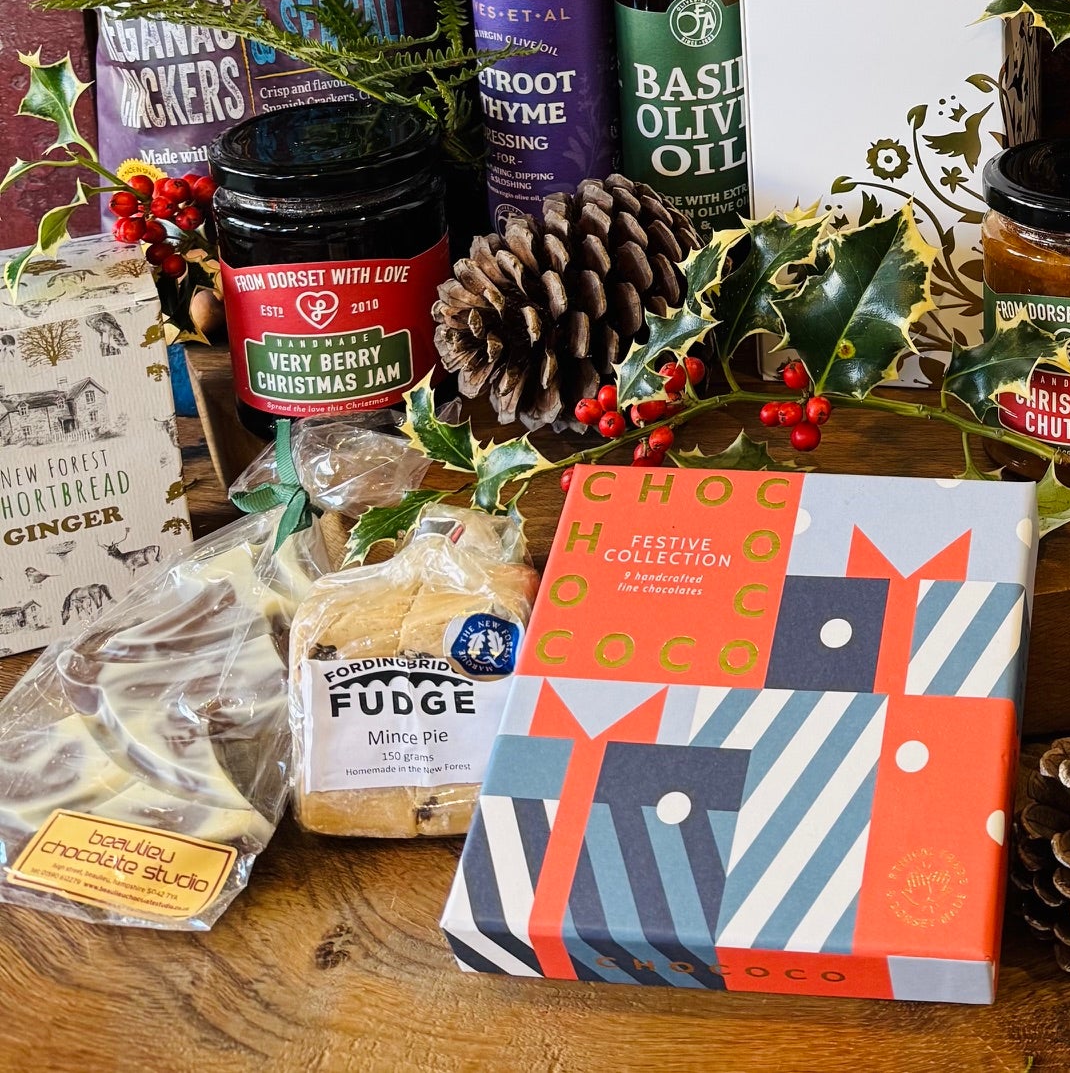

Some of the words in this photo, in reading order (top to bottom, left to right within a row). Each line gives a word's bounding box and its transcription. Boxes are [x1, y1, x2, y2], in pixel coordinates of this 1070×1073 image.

[480, 91, 567, 125] THYME
[651, 136, 746, 177] OIL
[515, 172, 555, 181] DIPPING
[685, 191, 720, 206] WITH
[697, 201, 734, 218] OLIVE
[234, 274, 266, 293] FROM
[268, 269, 325, 290] DORSET
[330, 266, 371, 286] WITH
[374, 265, 410, 285] LOVE
[351, 298, 380, 315] 2010
[276, 332, 370, 348] HANDMADE
[268, 352, 313, 373] VERY
[320, 344, 382, 372] BERRY
[256, 371, 358, 396] CHRISTMAS
[363, 361, 401, 389] JAM
[1, 465, 40, 490] NEW
[47, 449, 109, 478] FOREST
[3, 506, 125, 547] GINGER
[630, 534, 712, 552] FESTIVE
[604, 549, 732, 568] COLLECTION
[633, 571, 704, 585] handcrafted
[616, 581, 639, 594] fine
[641, 583, 703, 597] chocolates
[330, 690, 476, 718] FUDGE
[368, 730, 418, 746] Mince
[422, 729, 449, 745] Pie
[382, 752, 400, 762] 150
[403, 752, 435, 764] grams
[345, 764, 397, 776] Homemade
[444, 761, 472, 772] Forest
[88, 829, 176, 865] beaulieu
[40, 839, 139, 876] chocolate
[143, 863, 211, 894] studio
[594, 954, 848, 986] CHOCOCO
